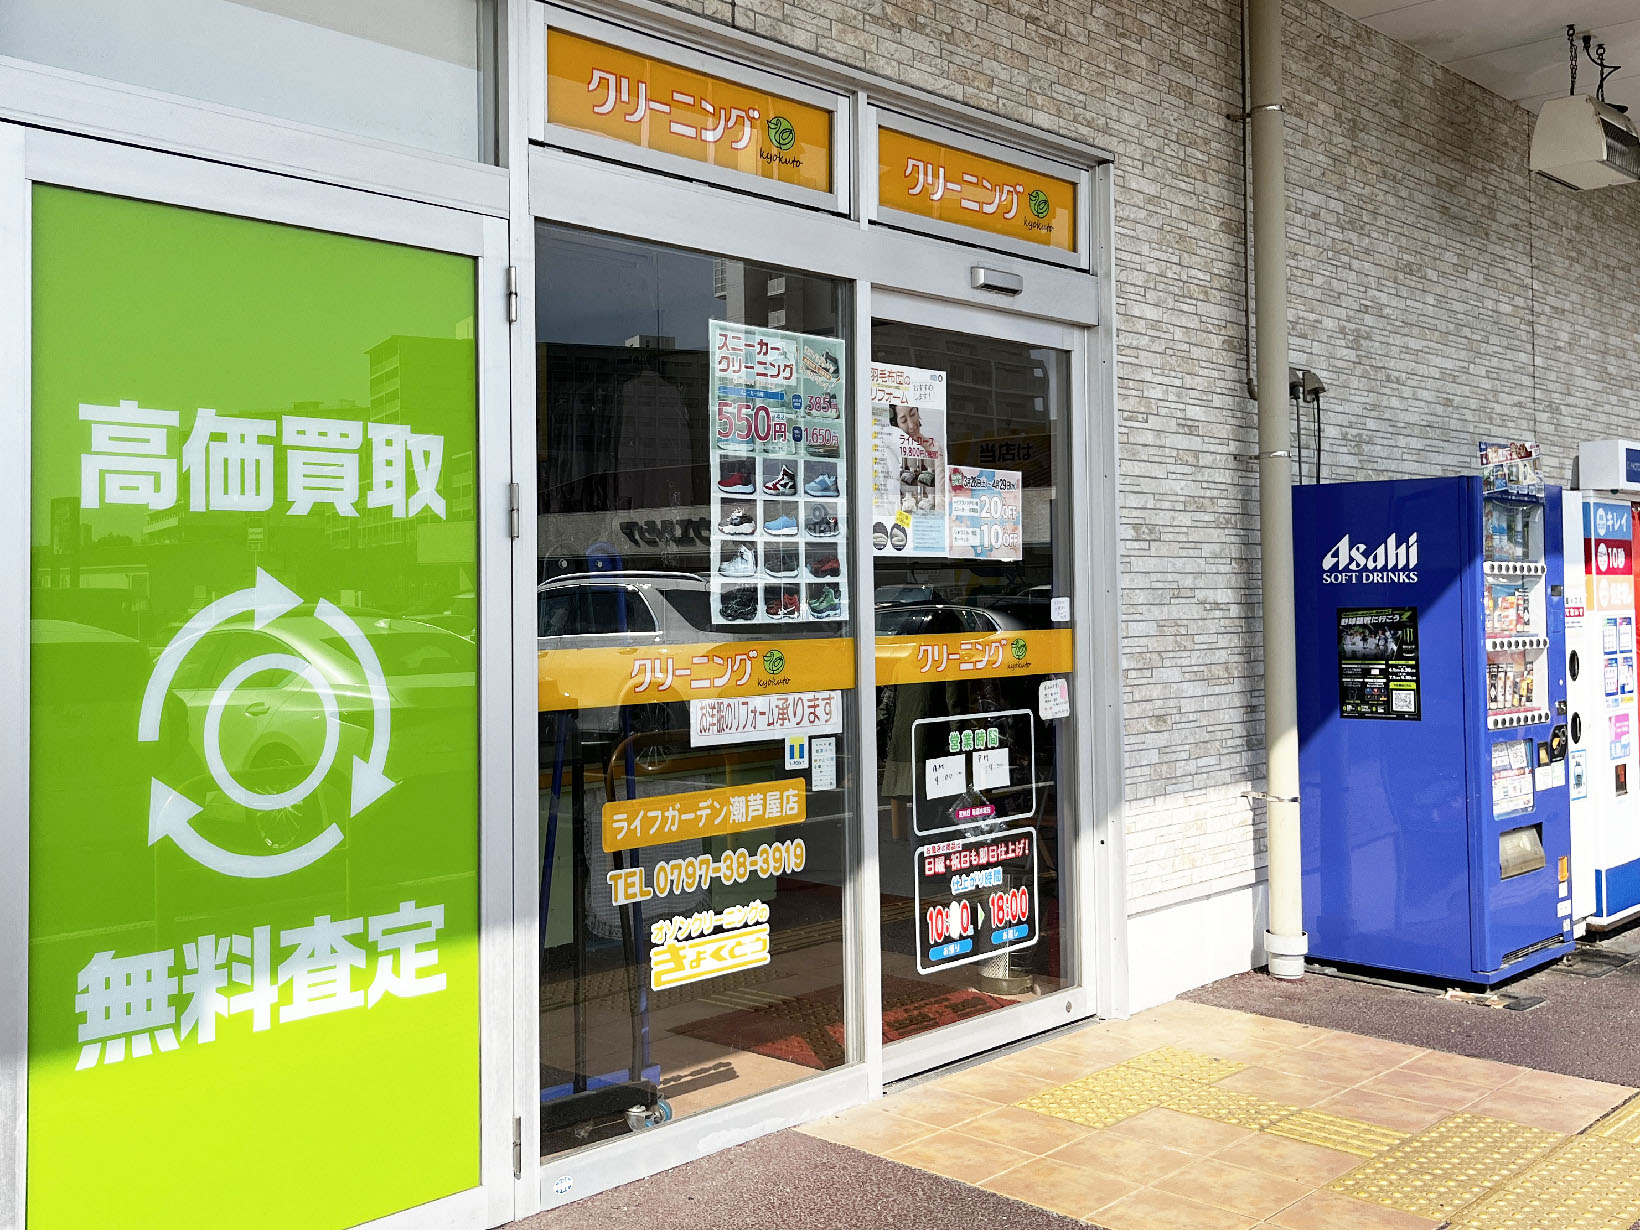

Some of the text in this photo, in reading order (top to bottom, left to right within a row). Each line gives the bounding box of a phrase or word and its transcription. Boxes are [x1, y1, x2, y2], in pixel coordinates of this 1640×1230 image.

[587, 67, 761, 151] クリーニング
[759, 148, 804, 169] kyokuto
[903, 157, 1024, 220] クリーニング
[1024, 216, 1055, 233] kyokuto
[717, 332, 782, 357] スニーカー
[718, 355, 794, 380] クリーニング
[717, 401, 788, 443] 550円
[79, 400, 448, 520] 高価買取
[979, 440, 1033, 464] 当店は
[1322, 531, 1418, 571] Asahi
[1322, 571, 1418, 584] SOFT DRINKS
[630, 649, 758, 694] クリーニング
[917, 638, 1007, 673] クリーニング
[698, 694, 836, 735] お洋服のリフォーム承ります
[949, 728, 1000, 752] 営業時間
[611, 787, 800, 841] ライフガーデン潮芦屋店
[607, 838, 806, 906] TEL 0797-38-3919
[951, 866, 1003, 894] 仕上がり時間
[651, 899, 770, 944] オゾンクリーニングの
[927, 899, 971, 944] 10:0
[989, 885, 1029, 929] 18:00
[74, 900, 448, 1072] 無料査定
